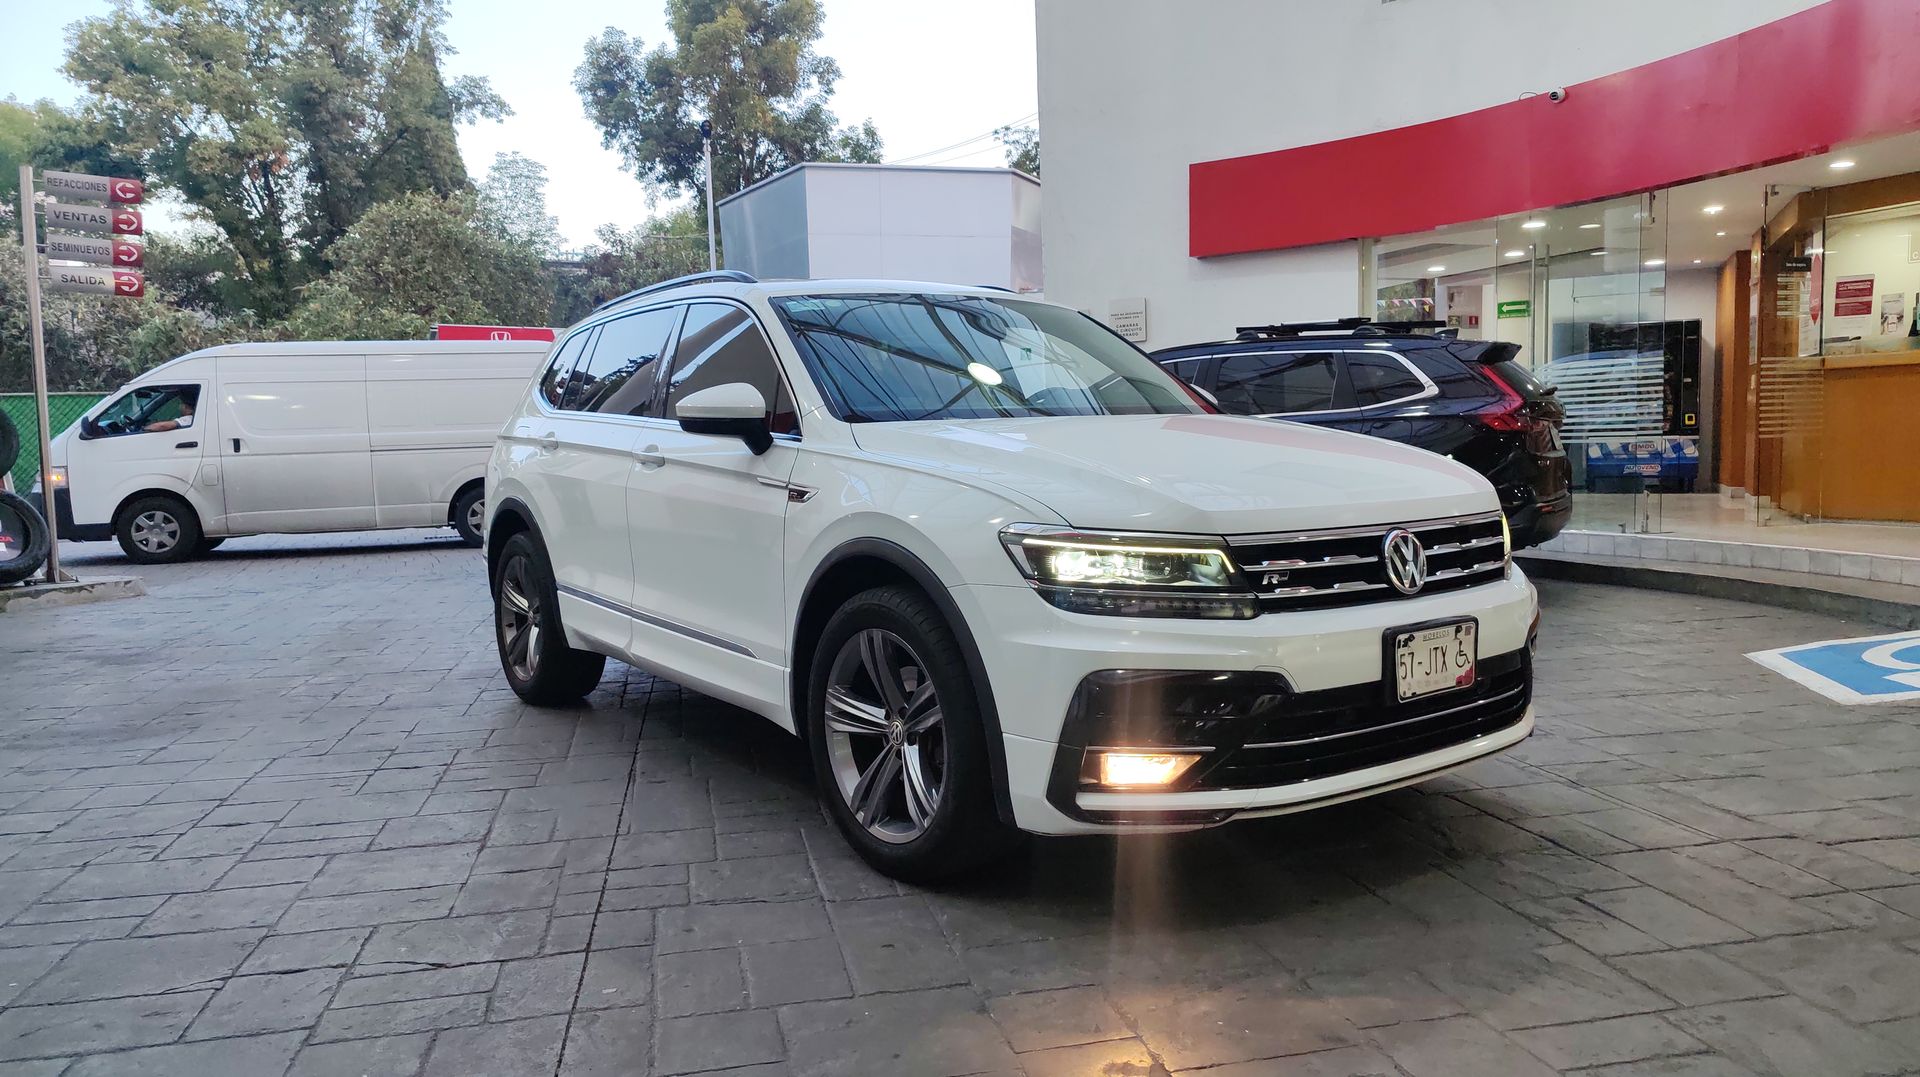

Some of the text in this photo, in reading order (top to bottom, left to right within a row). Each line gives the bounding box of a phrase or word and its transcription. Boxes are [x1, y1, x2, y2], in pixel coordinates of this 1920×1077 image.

[46, 178, 107, 192] REFACCIONES
[53, 210, 107, 224] VENTAS
[51, 242, 111, 256] SEMINUEVOS
[60, 274, 106, 286] SALIDA
[1399, 645, 1448, 680] 57-JTX
